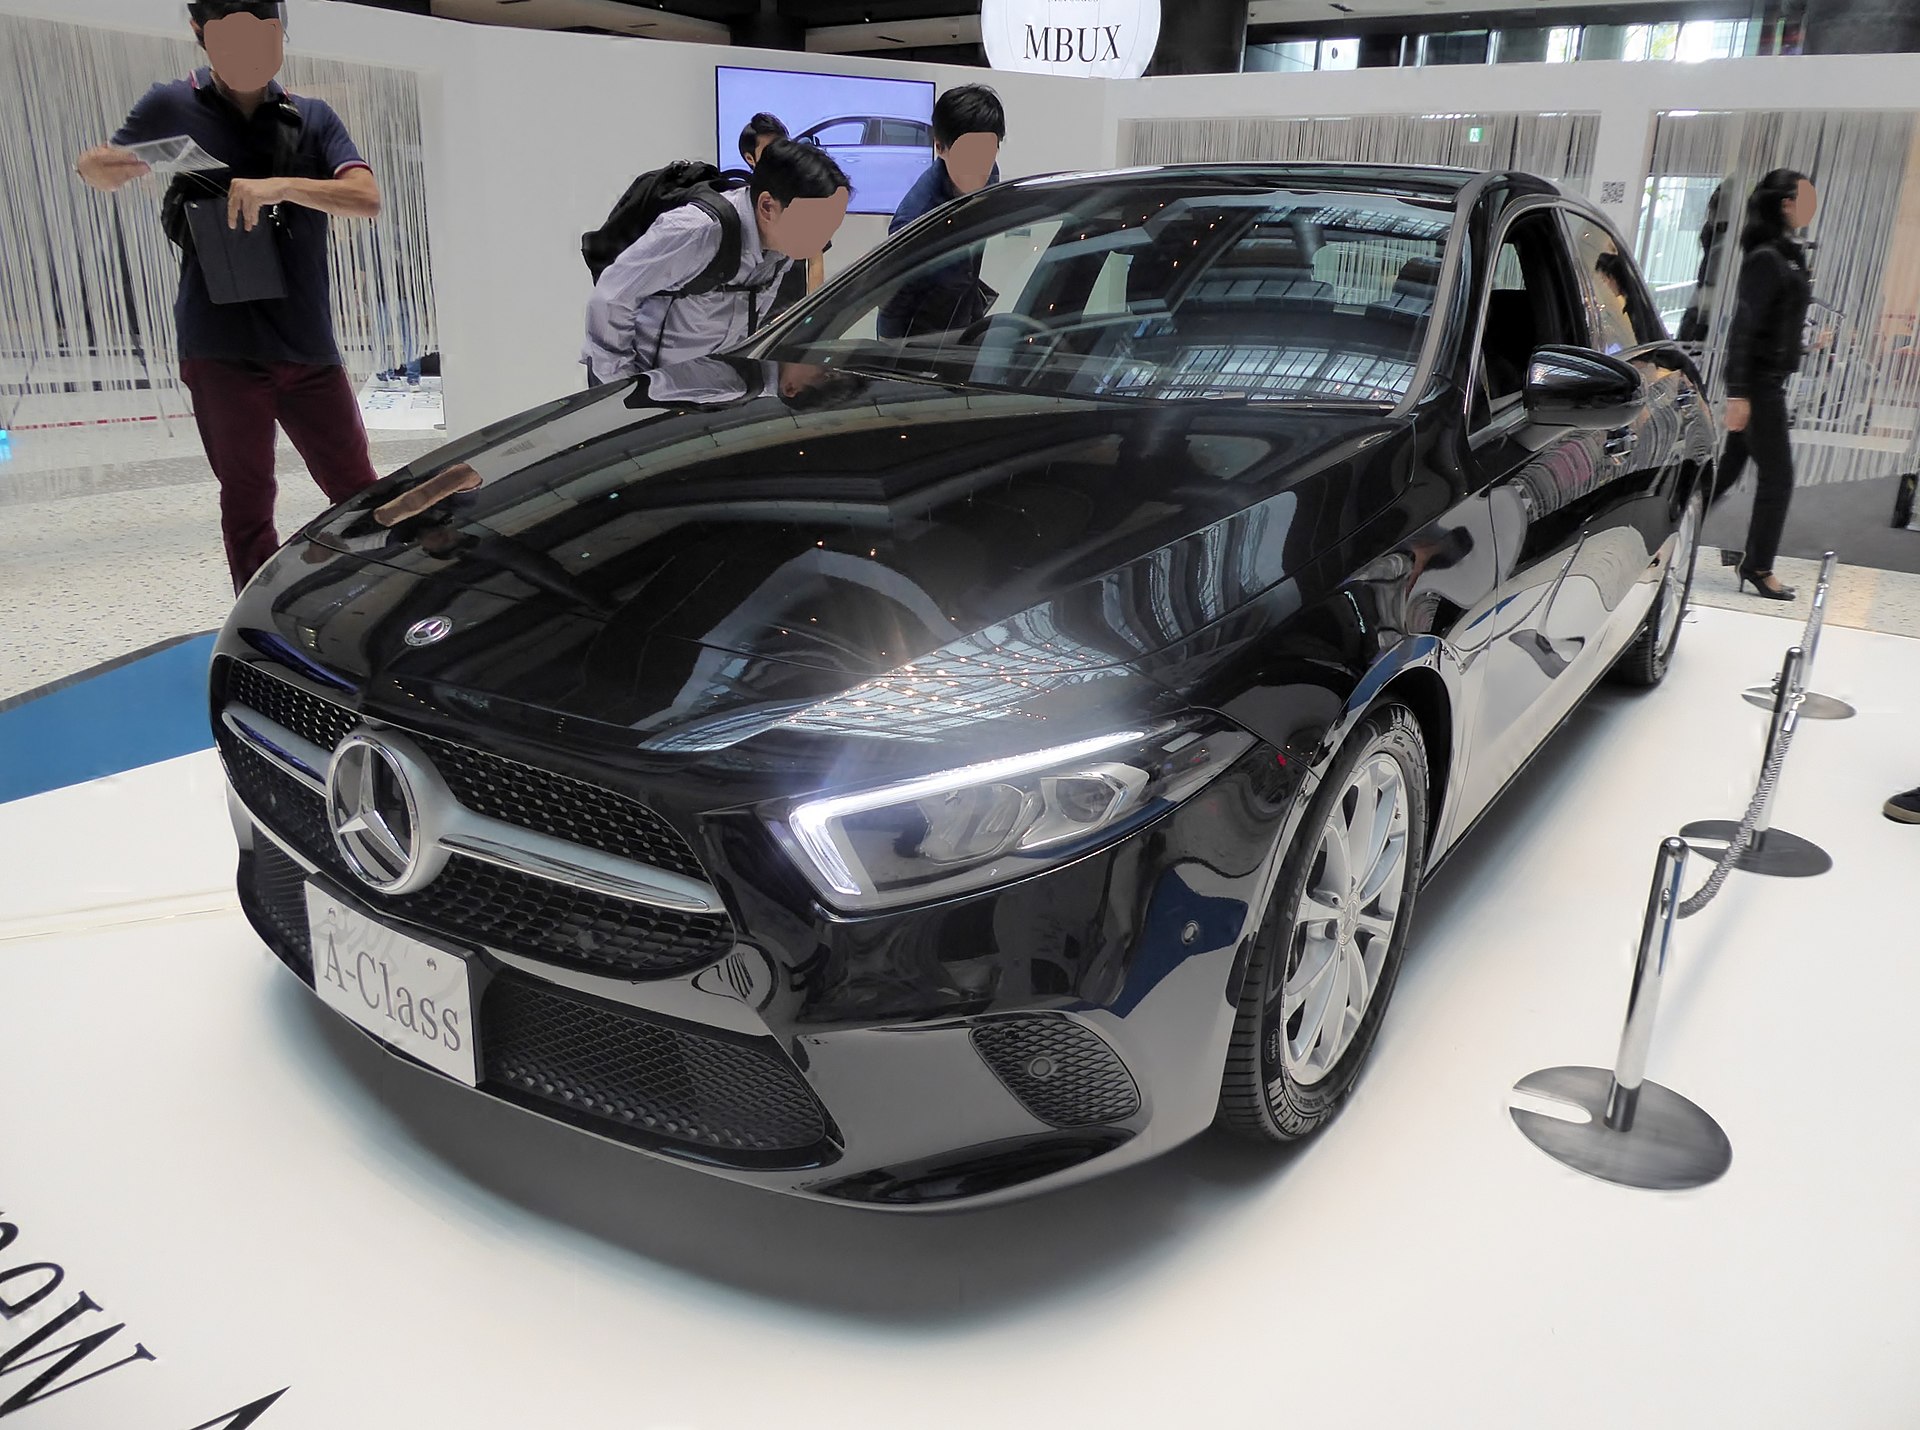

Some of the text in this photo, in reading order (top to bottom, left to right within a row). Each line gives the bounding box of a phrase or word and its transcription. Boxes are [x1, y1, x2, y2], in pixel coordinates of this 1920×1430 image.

[1023, 24, 1122, 63] MBUX
[324, 930, 461, 1052] A-Class
[1267, 1077, 1319, 1134] MICHELIN
